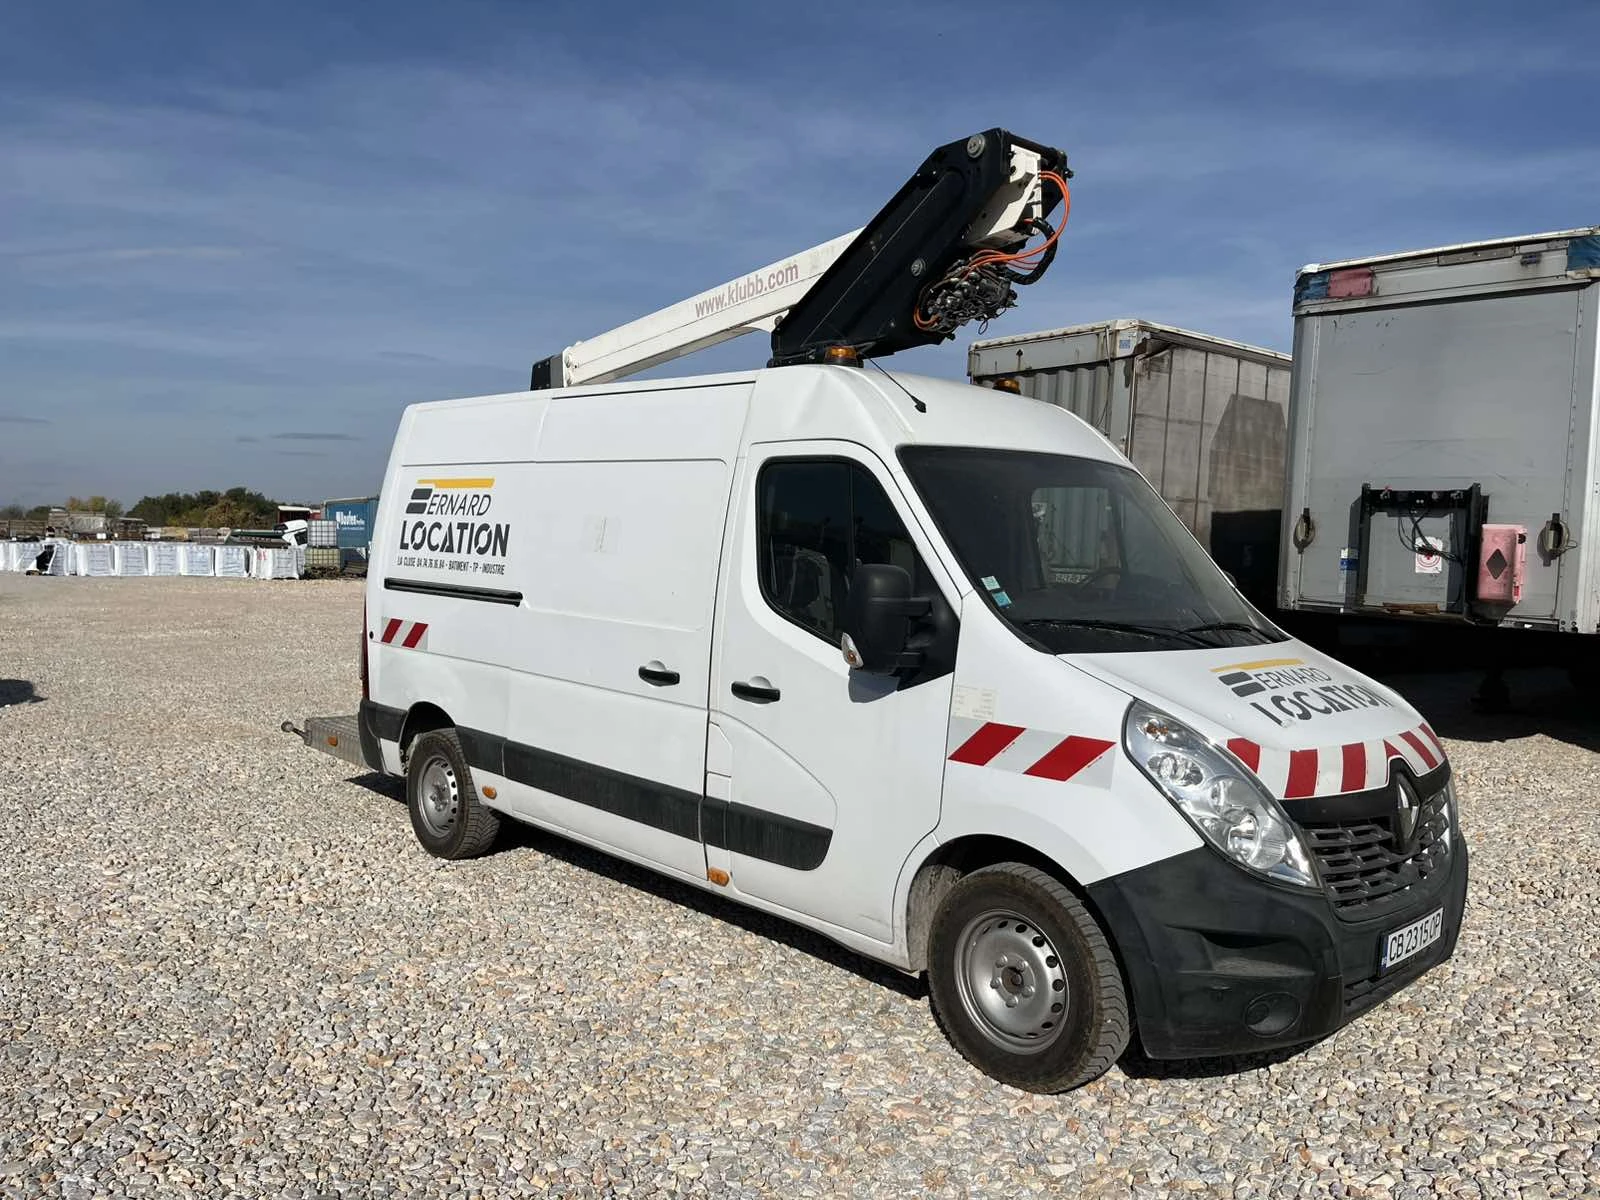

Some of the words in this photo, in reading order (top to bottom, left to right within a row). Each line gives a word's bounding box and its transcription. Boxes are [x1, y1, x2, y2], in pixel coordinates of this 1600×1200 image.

[695, 263, 799, 318] www.klubb.com
[400, 520, 510, 557] LOCATION
[472, 562, 479, 572] TP
